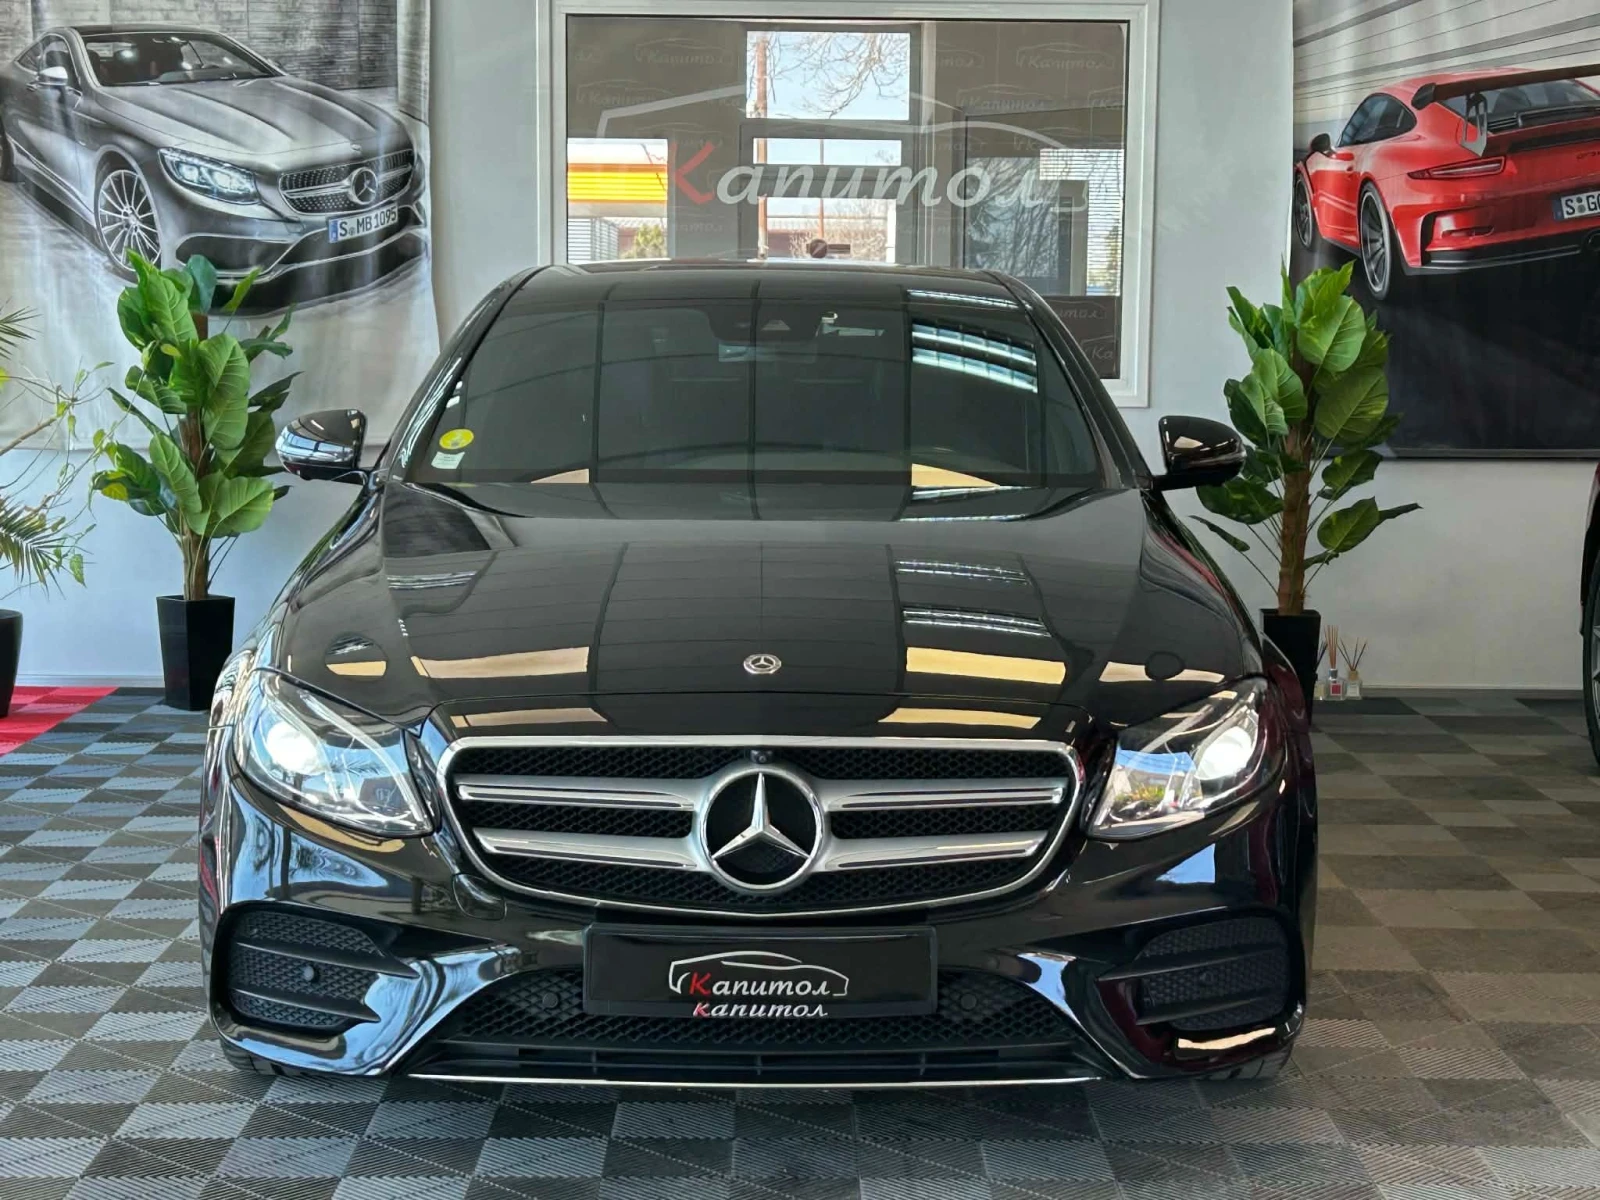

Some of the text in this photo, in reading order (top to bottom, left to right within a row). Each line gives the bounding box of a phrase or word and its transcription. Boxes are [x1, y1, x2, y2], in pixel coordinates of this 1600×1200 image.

[667, 140, 1044, 207] Капитол
[1564, 198, 1576, 216] S
[338, 221, 348, 237] S
[689, 972, 830, 996] Капитол
